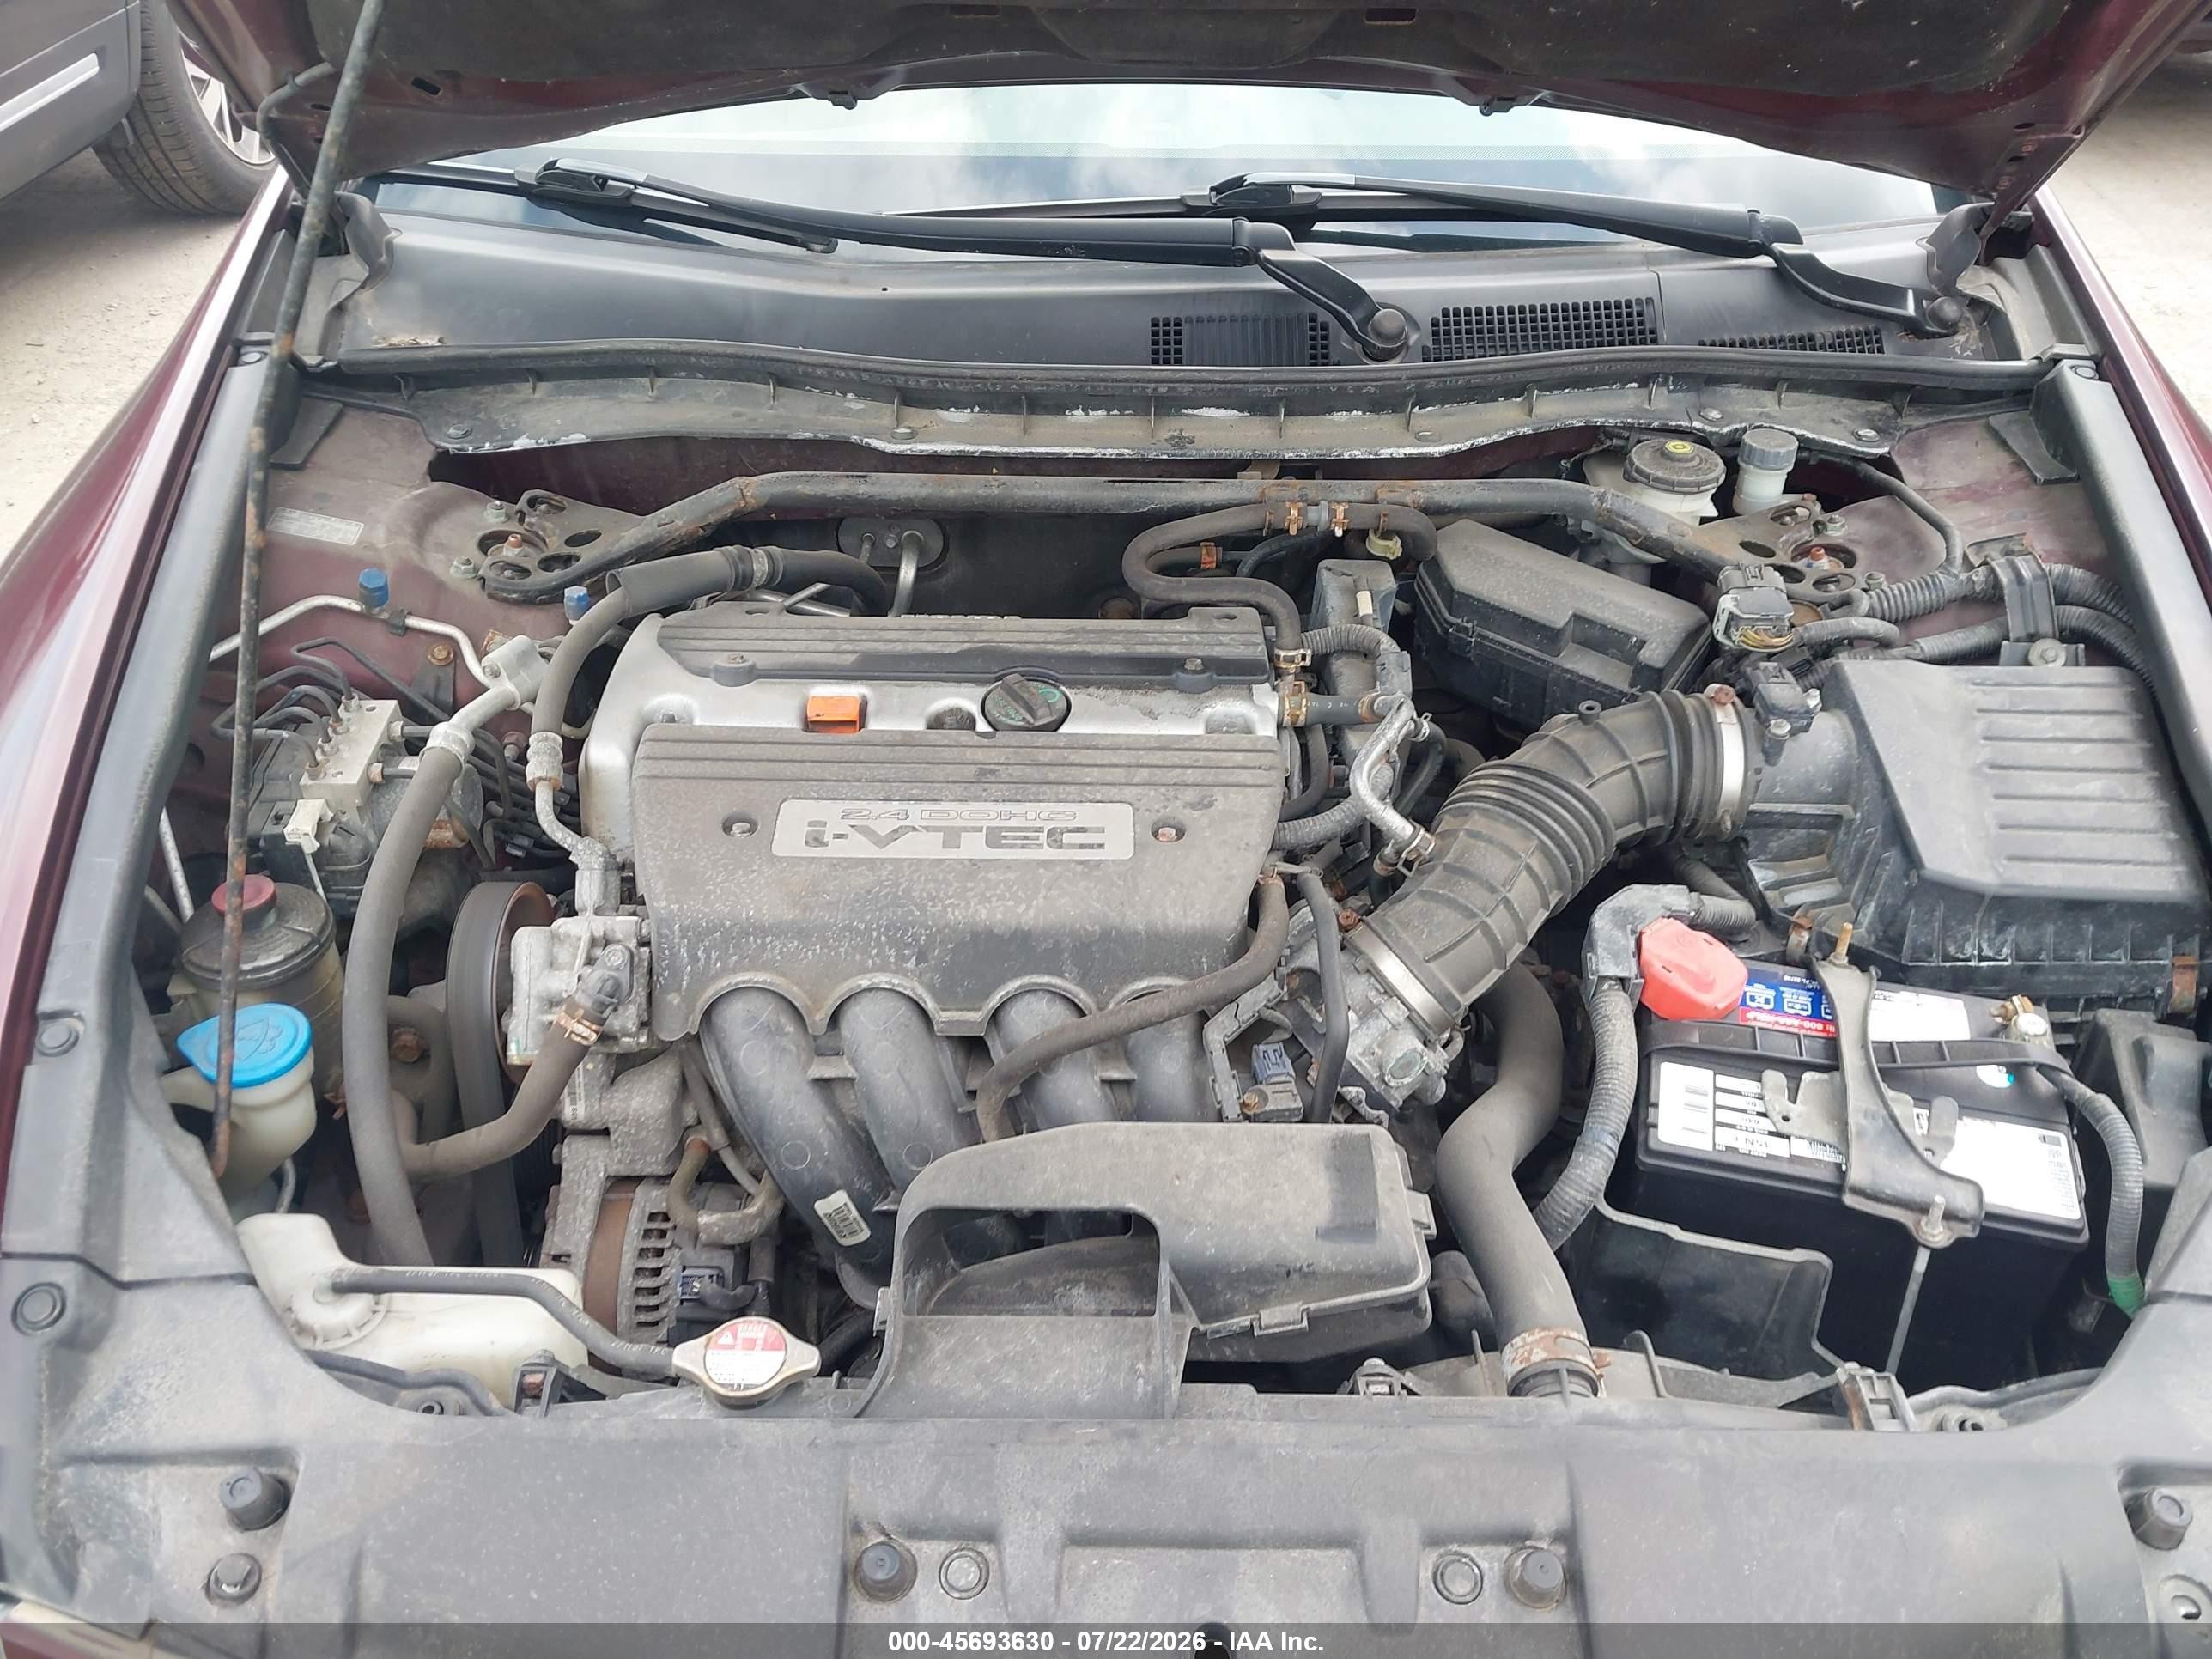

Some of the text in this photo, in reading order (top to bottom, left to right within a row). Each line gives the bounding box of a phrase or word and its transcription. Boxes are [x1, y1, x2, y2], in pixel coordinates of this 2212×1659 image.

[841, 808, 1077, 821] 2.4 DOHC
[804, 819, 1106, 850] i-VTEC
